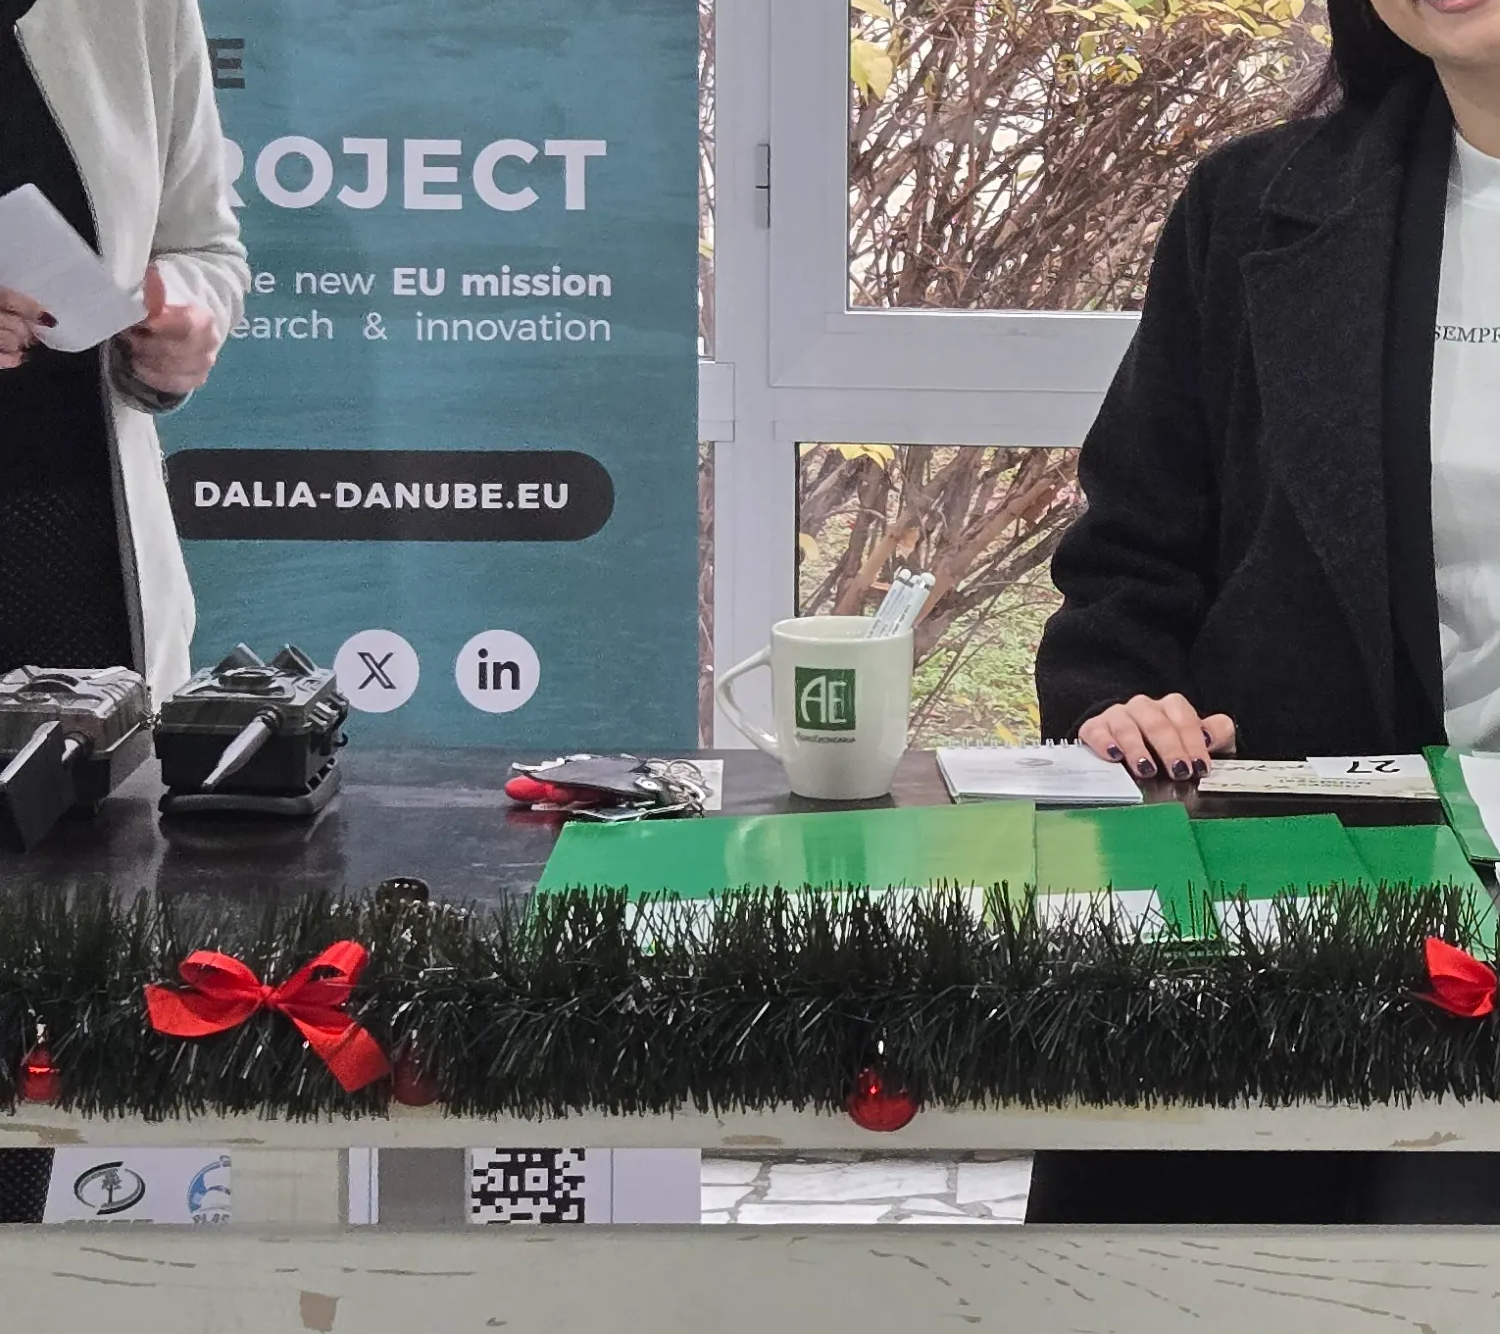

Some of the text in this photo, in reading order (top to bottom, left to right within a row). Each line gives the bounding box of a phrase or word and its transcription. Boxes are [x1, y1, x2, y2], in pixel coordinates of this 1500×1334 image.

[247, 264, 612, 298] e new EU mission
[363, 312, 388, 341] &
[416, 311, 612, 343] innovation
[194, 480, 570, 510] DALIA-DANUBE.EU
[478, 648, 521, 691] in
[1346, 760, 1401, 774] 27
